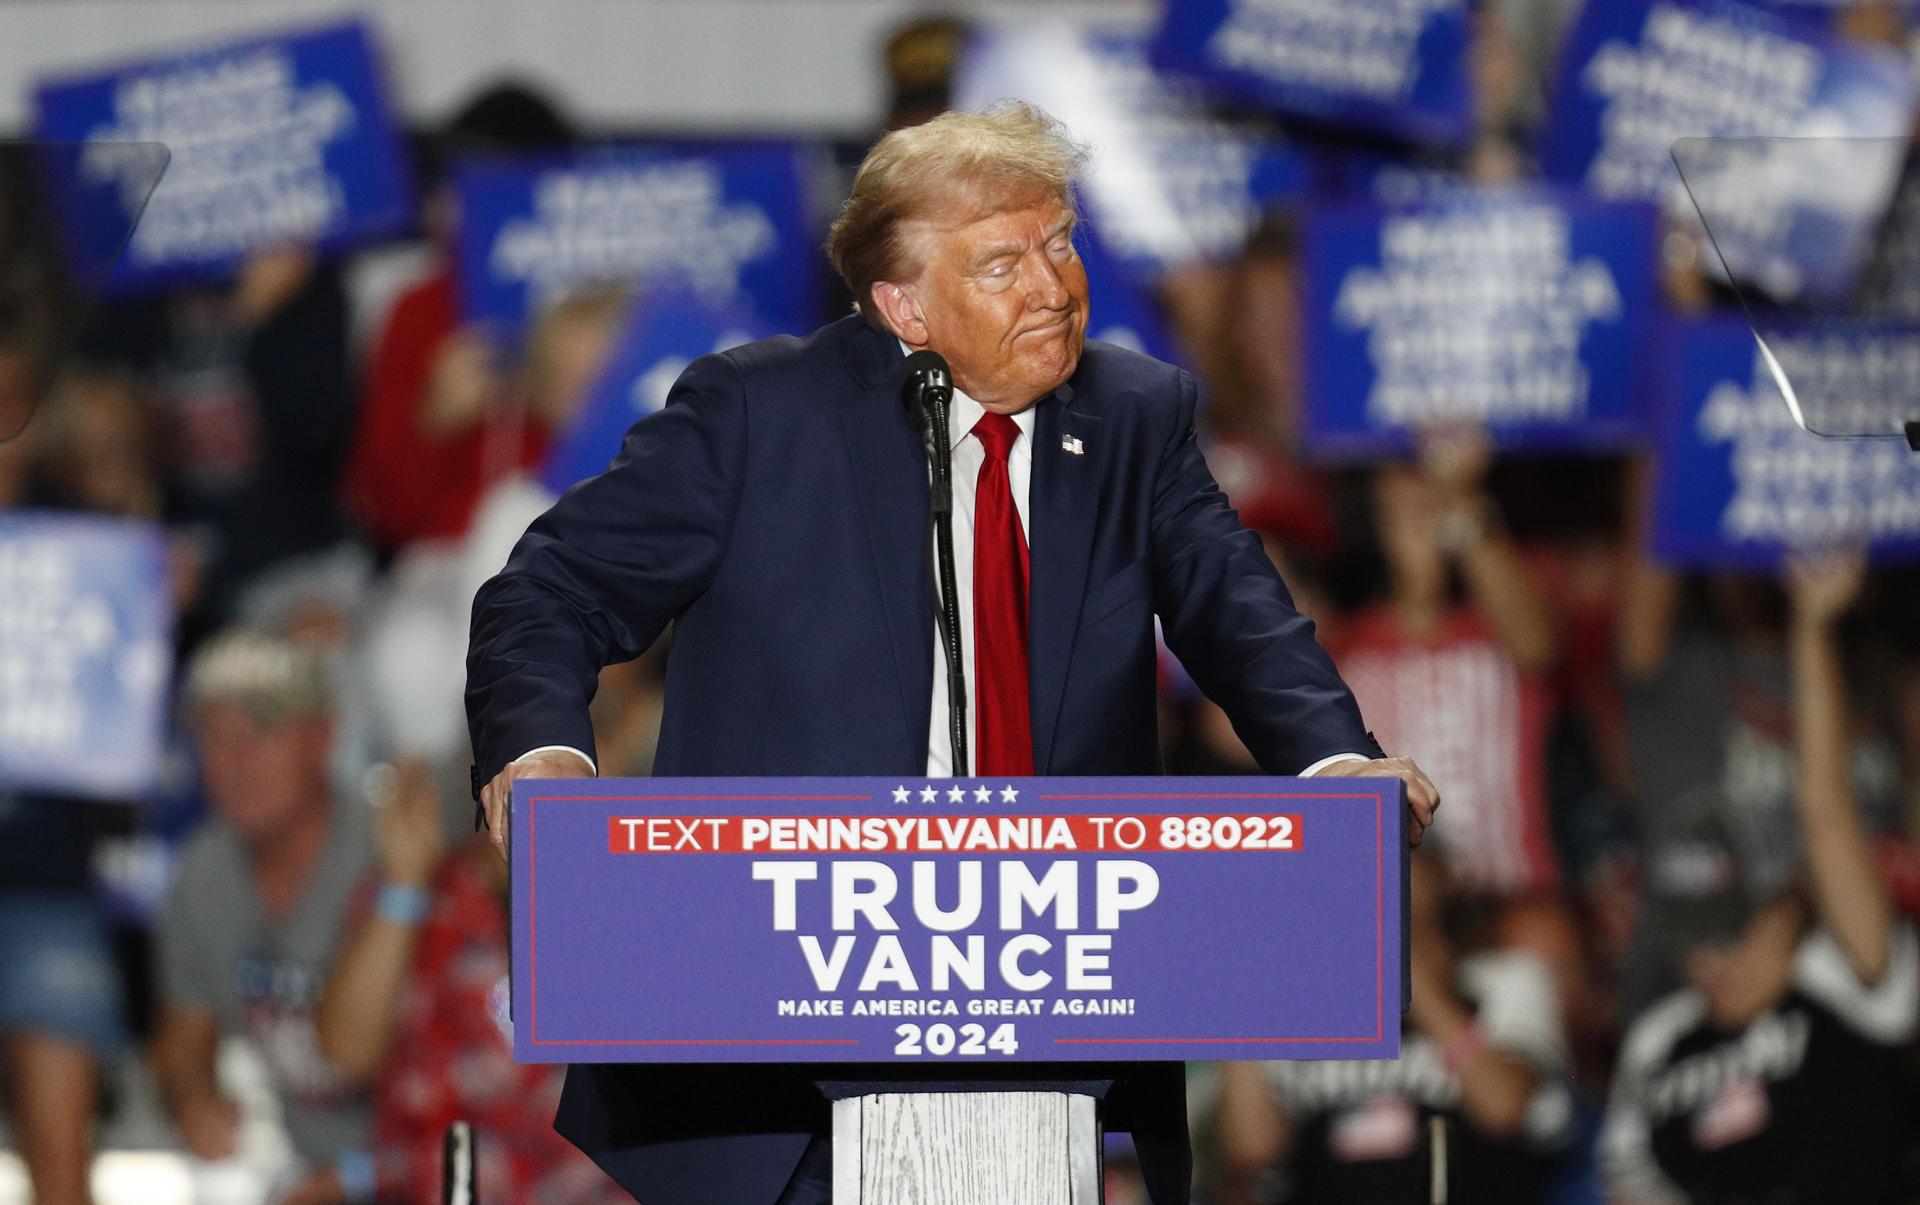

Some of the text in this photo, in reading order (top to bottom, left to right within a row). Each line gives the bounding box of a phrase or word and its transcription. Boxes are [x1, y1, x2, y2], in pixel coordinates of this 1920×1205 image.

[621, 817, 1292, 850] TEXT PENNSYLVANIA TO 88022
[752, 860, 1159, 931] TRUMP
[798, 934, 1112, 992] VANCE
[778, 998, 1135, 1016] MAKE AMERICA GREAT AGAIN!
[895, 1023, 1018, 1056] 2024
